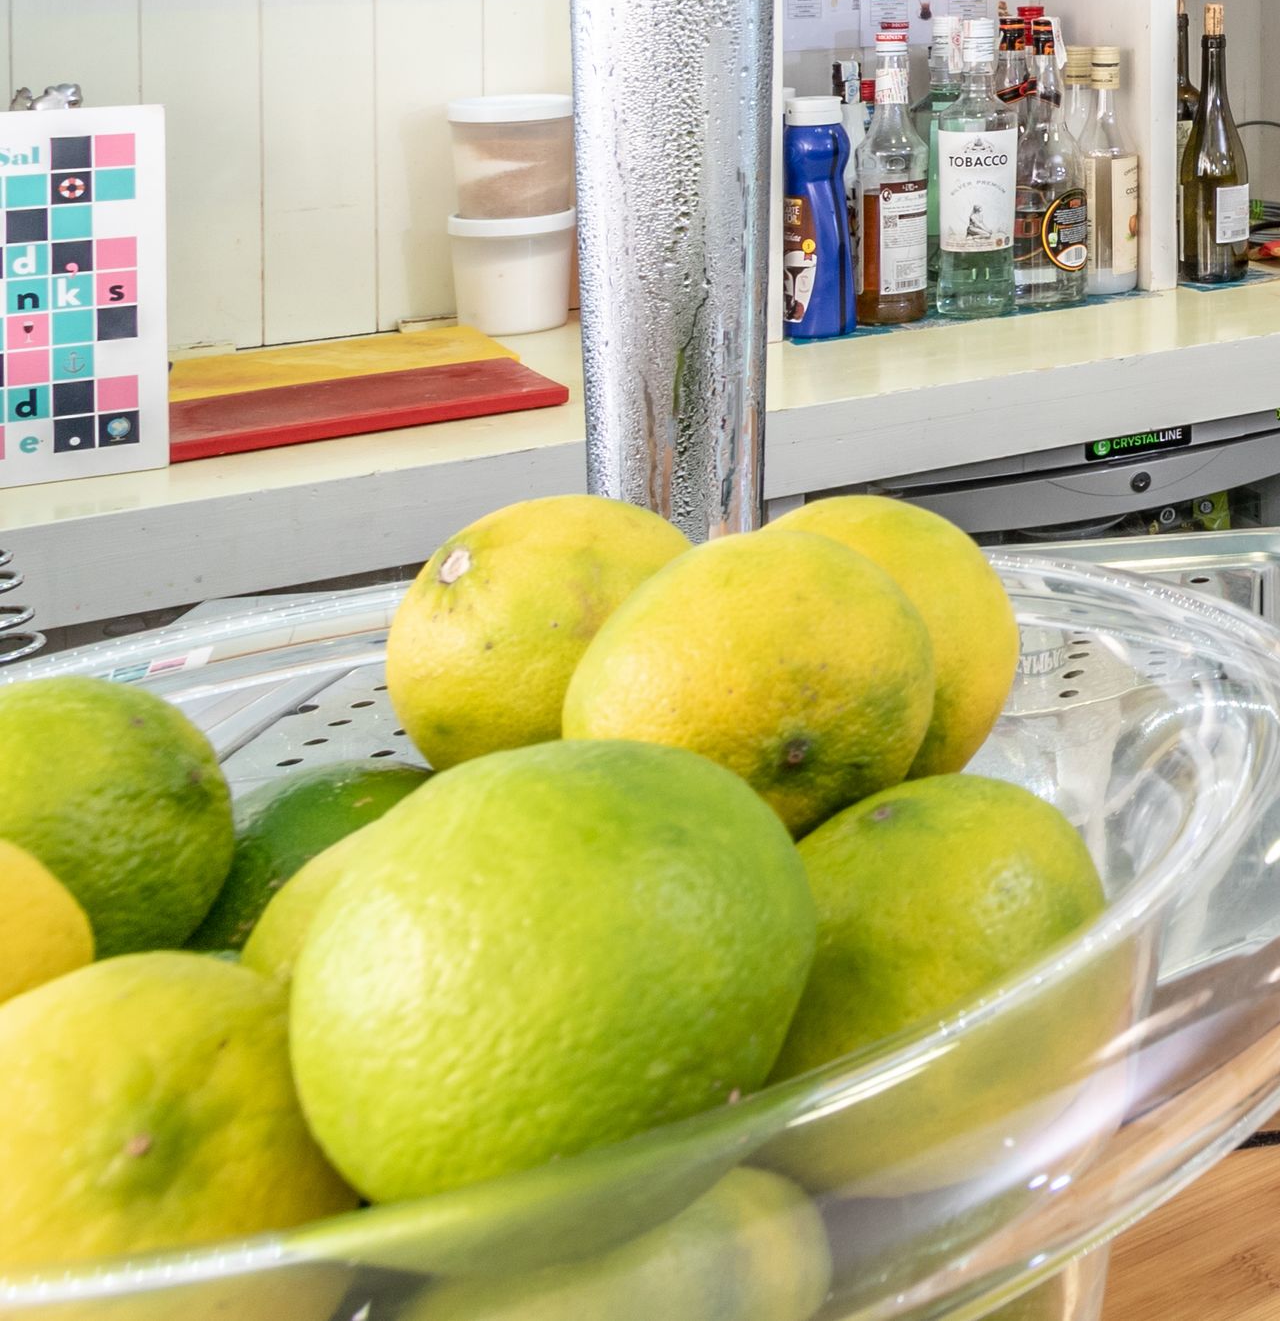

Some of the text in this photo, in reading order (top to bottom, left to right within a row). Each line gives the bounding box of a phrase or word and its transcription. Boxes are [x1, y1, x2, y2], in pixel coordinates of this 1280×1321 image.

[949, 154, 1008, 168] TOBACCO
[950, 179, 1006, 196] SILVER PREMIUM
[1113, 429, 1183, 450] CRYSTALLINE
